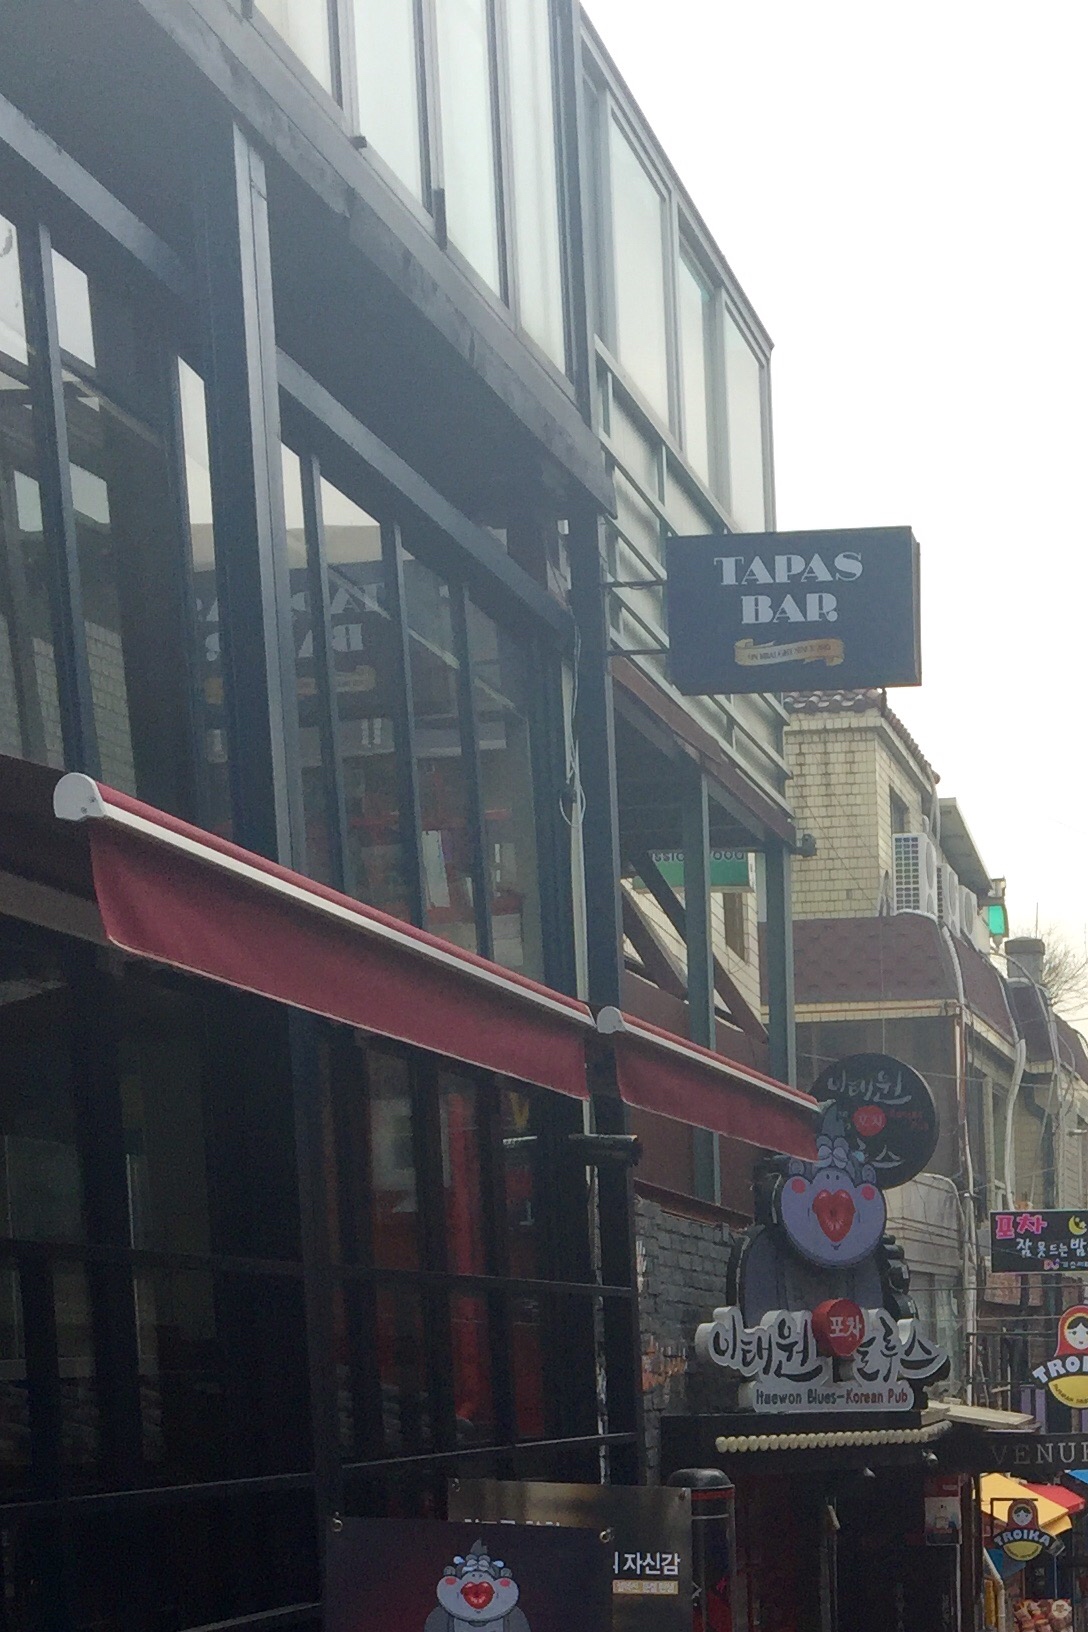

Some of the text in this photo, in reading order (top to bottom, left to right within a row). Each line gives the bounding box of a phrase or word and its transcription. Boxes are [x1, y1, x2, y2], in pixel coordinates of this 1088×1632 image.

[713, 551, 863, 586] TAPAS
[741, 592, 839, 625] BAR
[996, 1213, 1048, 1240] 포차
[829, 1316, 863, 1341] 포차
[712, 1314, 823, 1382] 이태원
[755, 1389, 803, 1406] Itaewon
[887, 1389, 908, 1404] Pub
[994, 1529, 1051, 1547] TROIKA
[623, 1551, 681, 1576] 자신감
